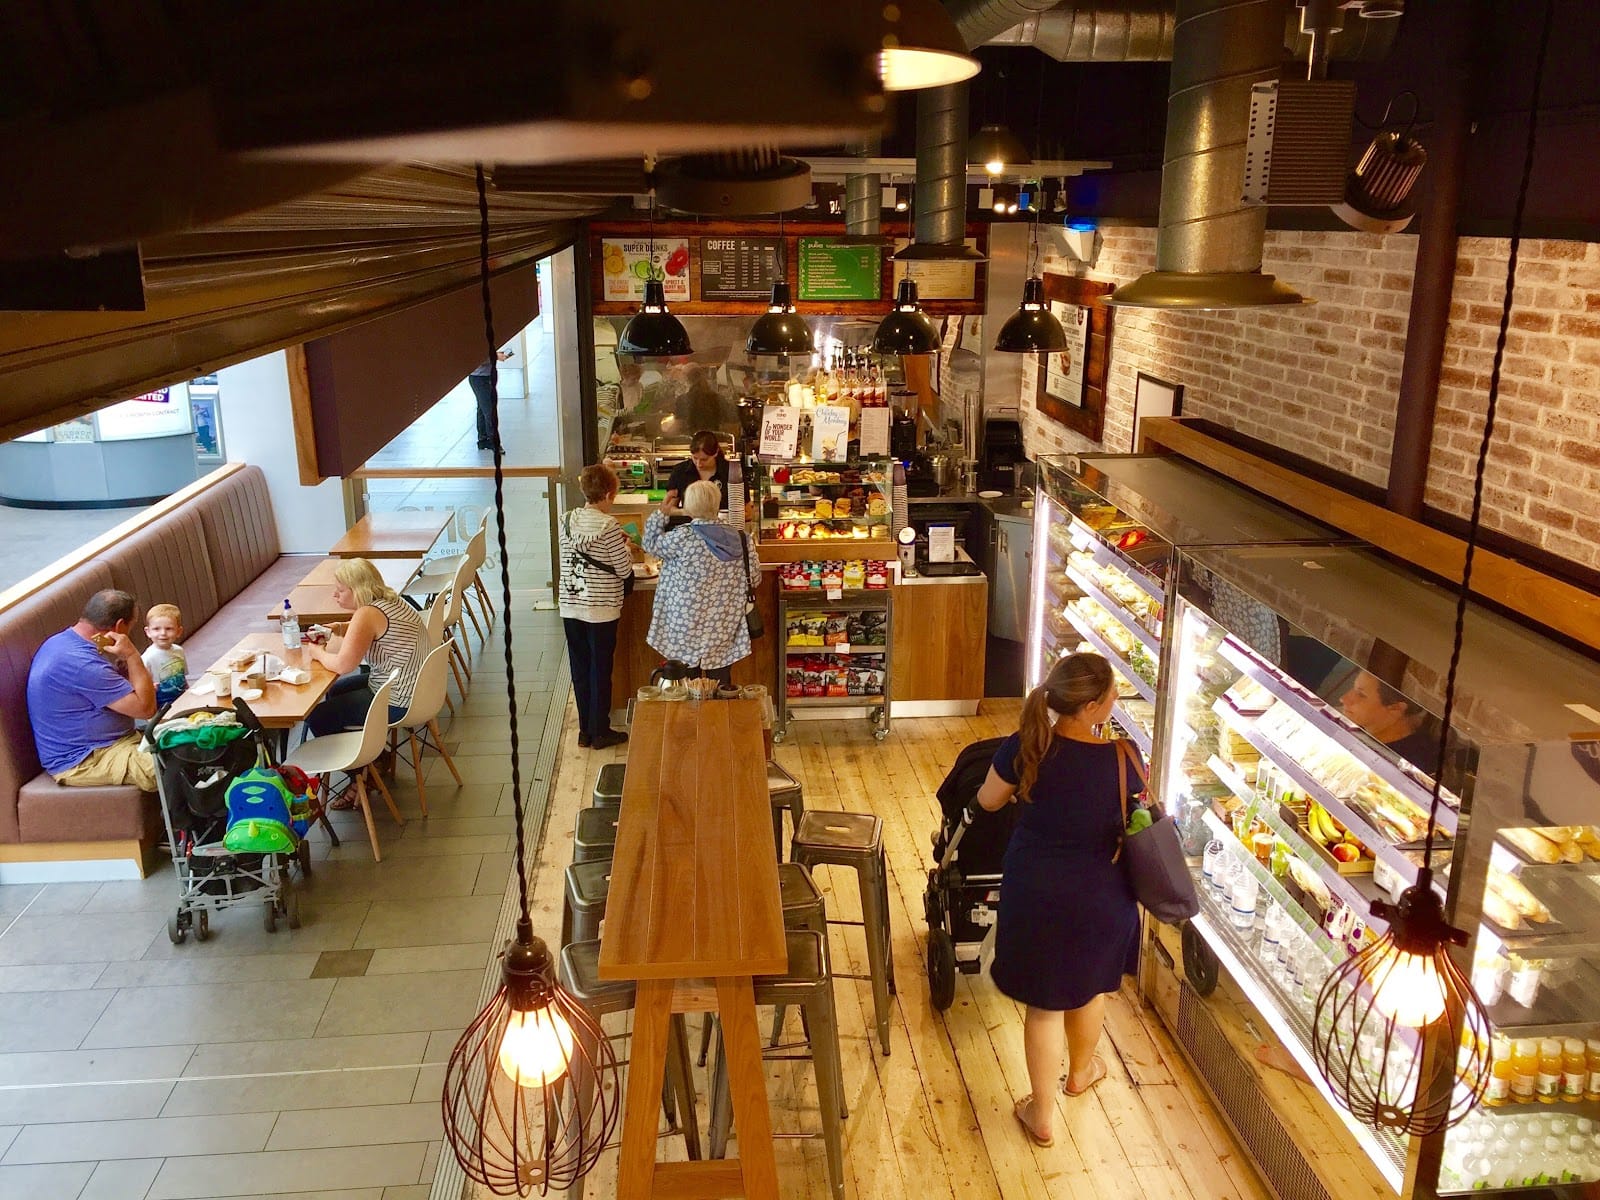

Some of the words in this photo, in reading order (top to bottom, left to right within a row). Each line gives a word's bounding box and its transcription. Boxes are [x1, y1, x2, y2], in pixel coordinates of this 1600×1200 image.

[623, 244, 644, 252] SUPER
[707, 240, 736, 250] COFFEE
[152, 408, 180, 417] CONTRACT
